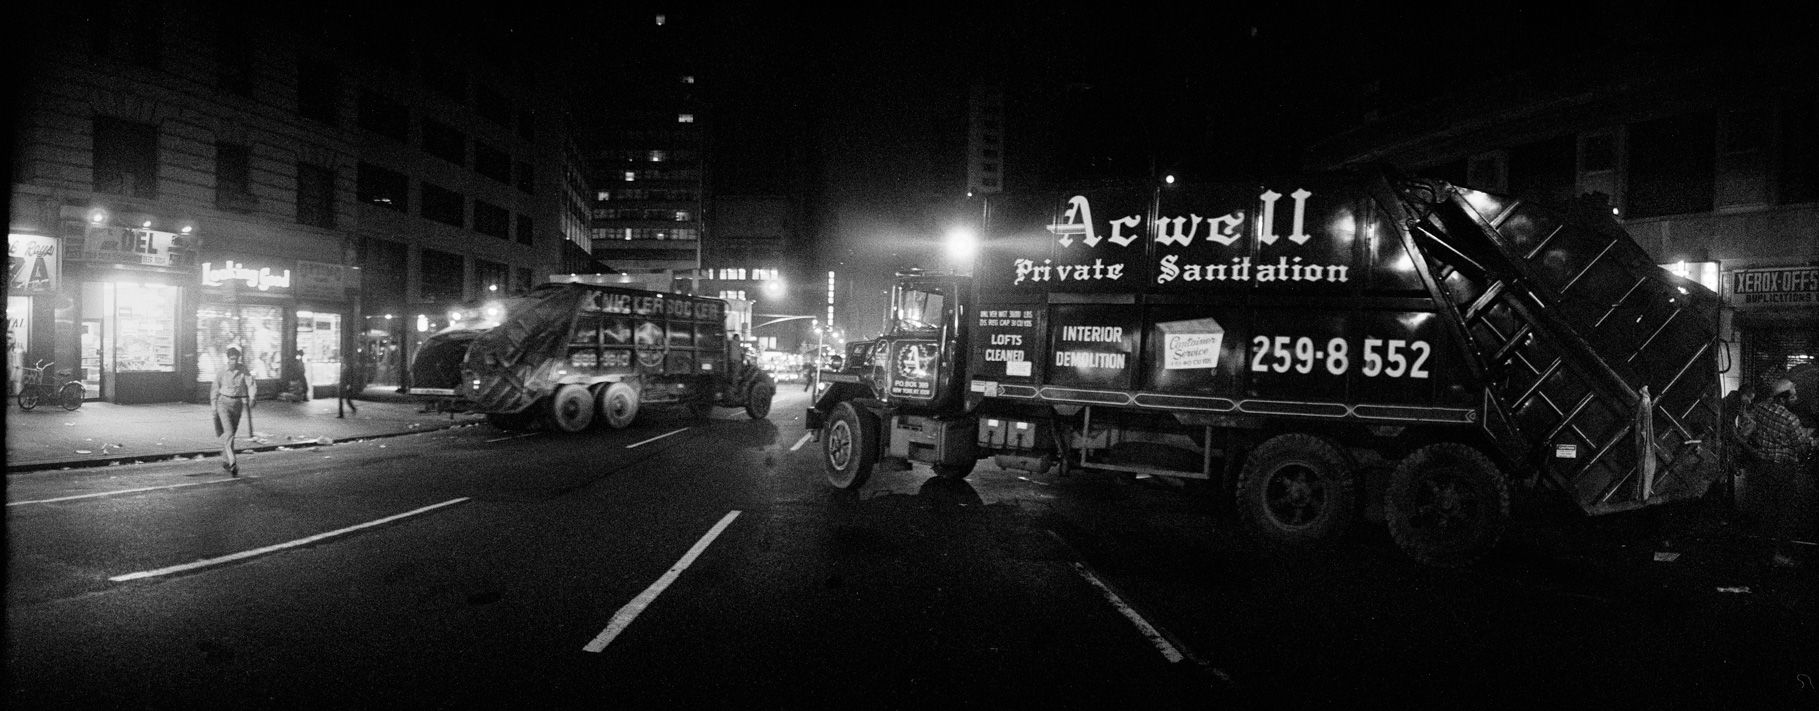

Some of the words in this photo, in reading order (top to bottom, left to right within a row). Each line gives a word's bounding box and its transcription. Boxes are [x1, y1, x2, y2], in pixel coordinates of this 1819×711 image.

[1046, 188, 1312, 248] Acwell
[1014, 258, 1124, 286] Private
[1157, 254, 1349, 284] Sanitation
[991, 334, 1022, 346] LOFTS
[1063, 326, 1122, 342] INTERIOR
[1170, 335, 1215, 351] Container
[985, 349, 1024, 361] CLEANED
[1056, 351, 1125, 369] DEMOLITION
